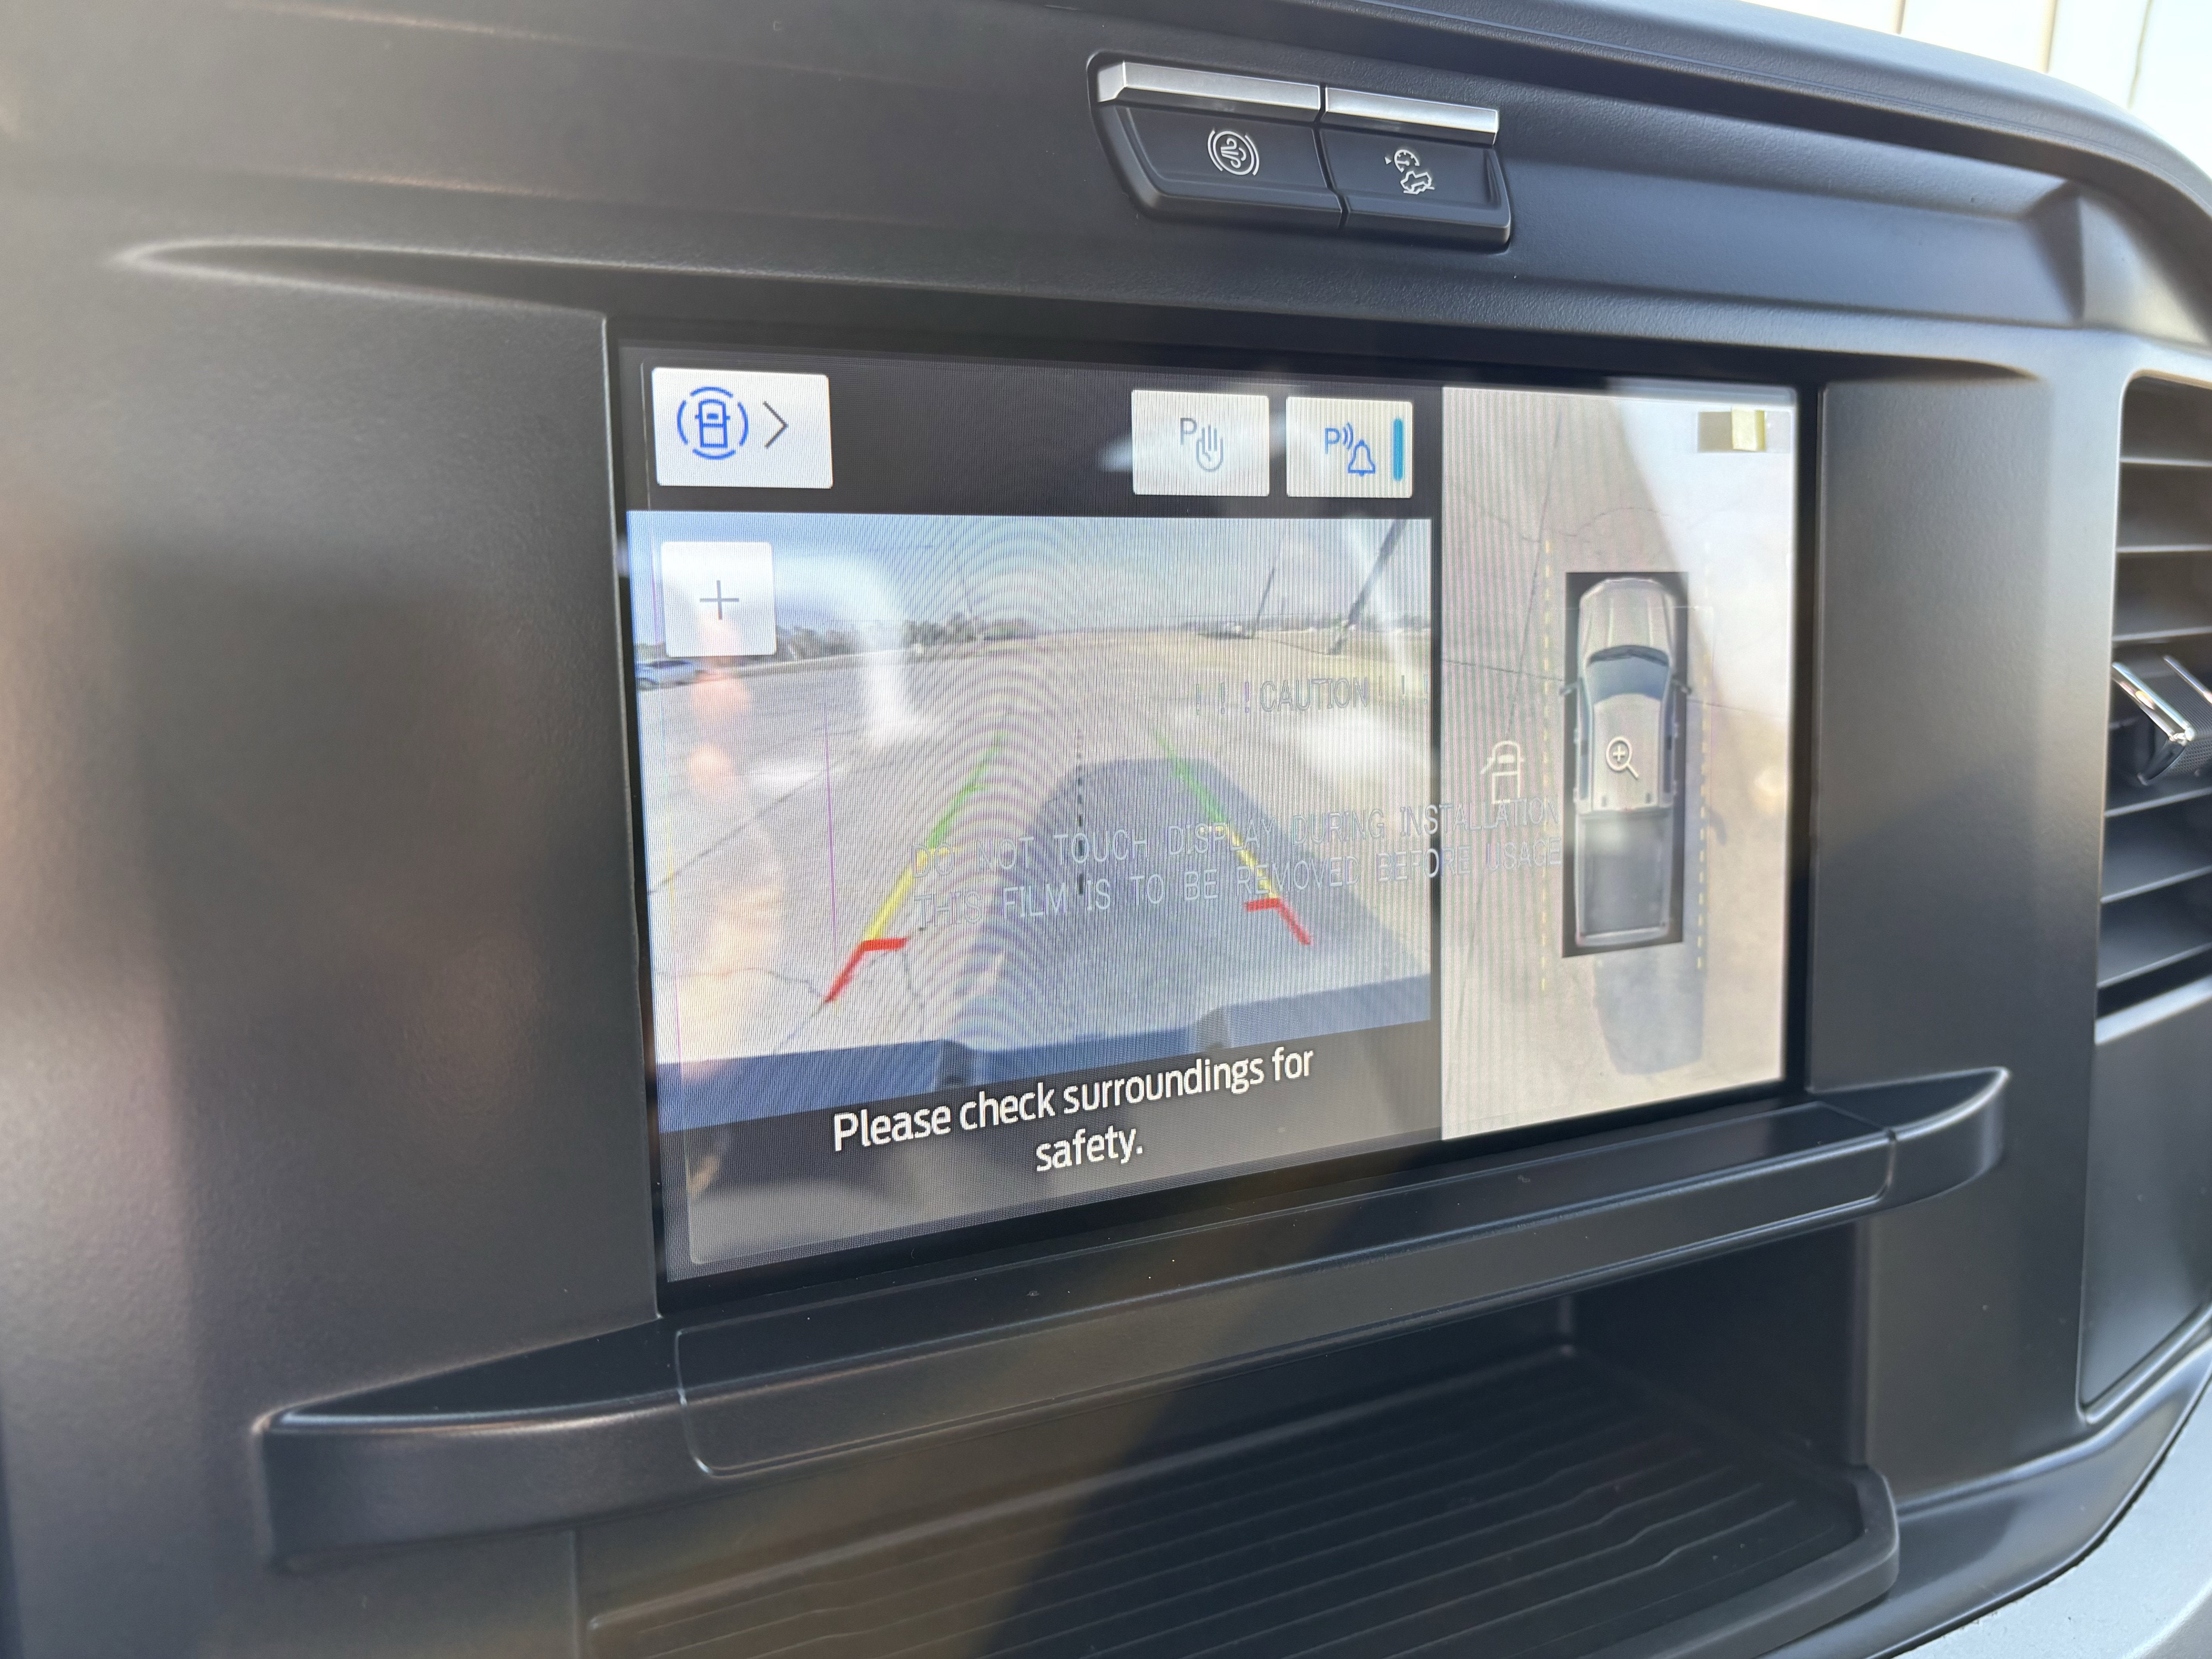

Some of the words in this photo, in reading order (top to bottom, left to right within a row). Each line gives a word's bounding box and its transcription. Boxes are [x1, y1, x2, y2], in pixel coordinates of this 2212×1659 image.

[912, 843, 955, 878] DO
[976, 836, 1035, 872] NOT
[1053, 830, 1148, 865] TOUCH
[1168, 817, 1275, 856] DISPLAY
[1292, 808, 1385, 846] DURING
[1399, 796, 1559, 837] INSTALLATION
[914, 891, 982, 930] THIS
[1003, 882, 1067, 919] FILM
[1086, 878, 1111, 911] IS
[1128, 873, 1164, 906] TO
[1183, 869, 1219, 901] BE
[1237, 855, 1360, 896] REMOVED
[1376, 845, 1471, 883] BEFORE
[1486, 838, 1562, 872] USAGE
[833, 1109, 951, 1152] Please
[960, 1082, 1055, 1130] check
[1063, 1058, 1264, 1114] surroundings
[1272, 1046, 1314, 1082] for
[1036, 1125, 1143, 1171] safety.
